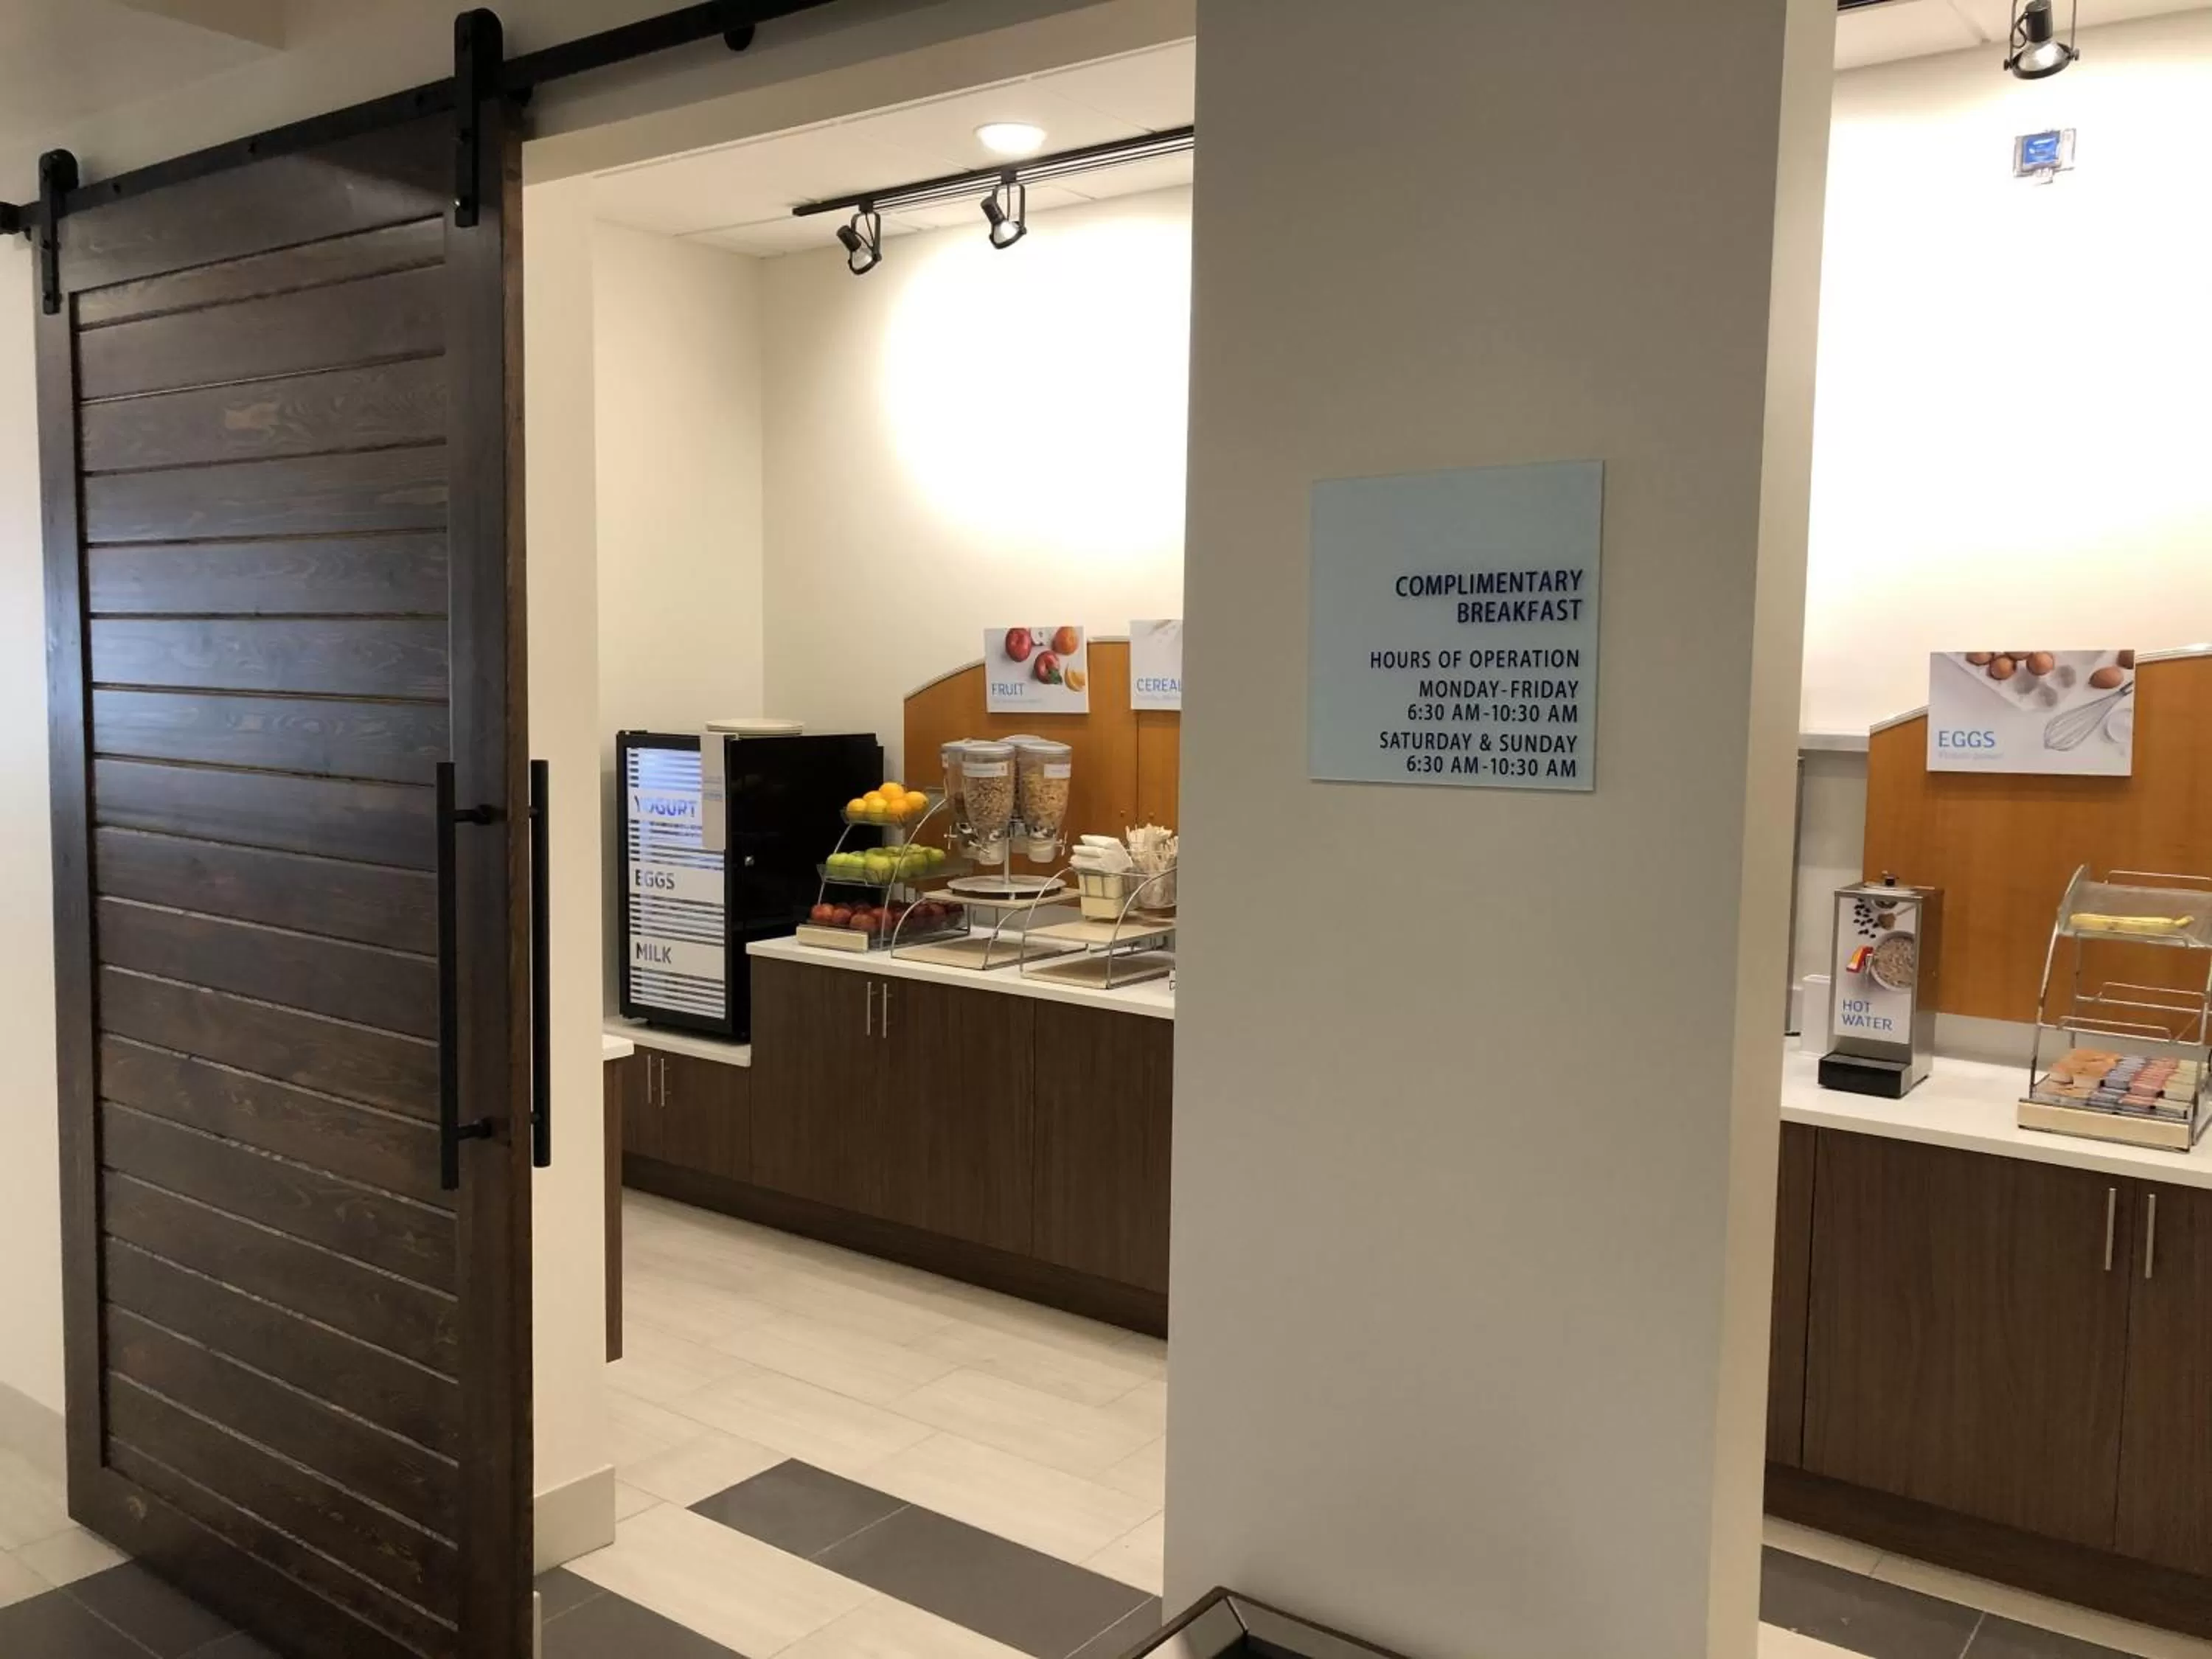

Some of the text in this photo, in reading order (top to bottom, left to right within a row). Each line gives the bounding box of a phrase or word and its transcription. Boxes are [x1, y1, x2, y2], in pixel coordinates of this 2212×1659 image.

[1395, 569, 1583, 597] COMPLIMENTARY
[1457, 599, 1582, 623] BREAKFAST
[1370, 649, 1579, 669] HOURS OF OPERATION
[991, 682, 1024, 697] FRUIT
[1408, 703, 1444, 721] 6:30
[1548, 704, 1578, 723] AM
[1380, 731, 1578, 754] SATURDAY & SUNDAY
[1938, 730, 1995, 748] EGGS
[1406, 755, 1443, 773] 6:30
[1545, 759, 1576, 778] AM
[635, 869, 675, 890] EGGS
[636, 942, 672, 964] MILK
[1843, 999, 1871, 1013] HOT
[1842, 1013, 1893, 1031] WATER
